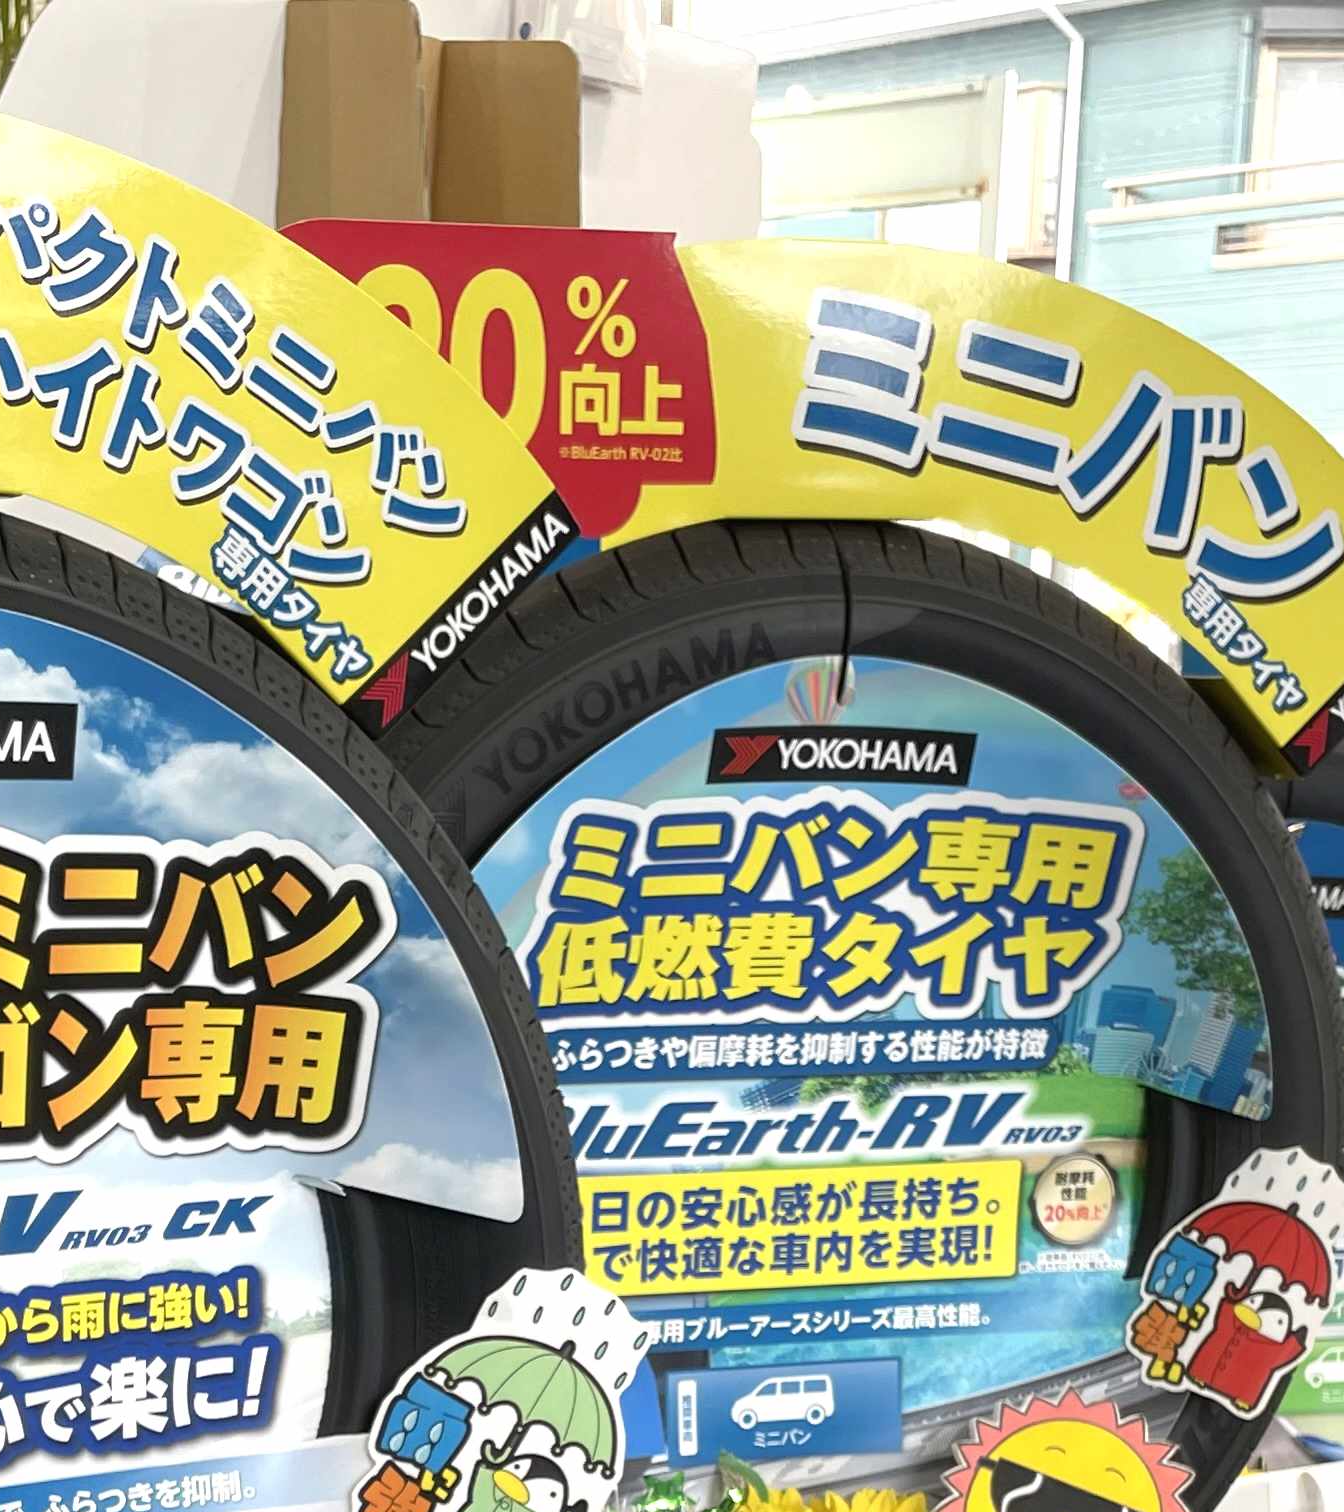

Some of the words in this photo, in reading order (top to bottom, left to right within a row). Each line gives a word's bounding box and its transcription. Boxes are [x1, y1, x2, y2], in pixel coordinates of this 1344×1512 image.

[559, 363, 685, 436] 向上
[213, 527, 371, 681] 専用タイヤ
[411, 513, 569, 672] YOKOHAMA
[1183, 574, 1307, 712] 専用タイヤ
[473, 622, 777, 796] YOKOHAMA
[777, 736, 958, 776] YOKOHAMA
[549, 807, 1120, 916] ミニバン専用
[537, 908, 1097, 1010] 低燃費タイヤ
[1003, 1126, 1082, 1145] RV03
[59, 1224, 150, 1248] RV03
[163, 1192, 277, 1242] CK
[590, 1180, 1001, 1234] 日の安心感が長持ち。
[754, 1430, 811, 1448] ミニバン
